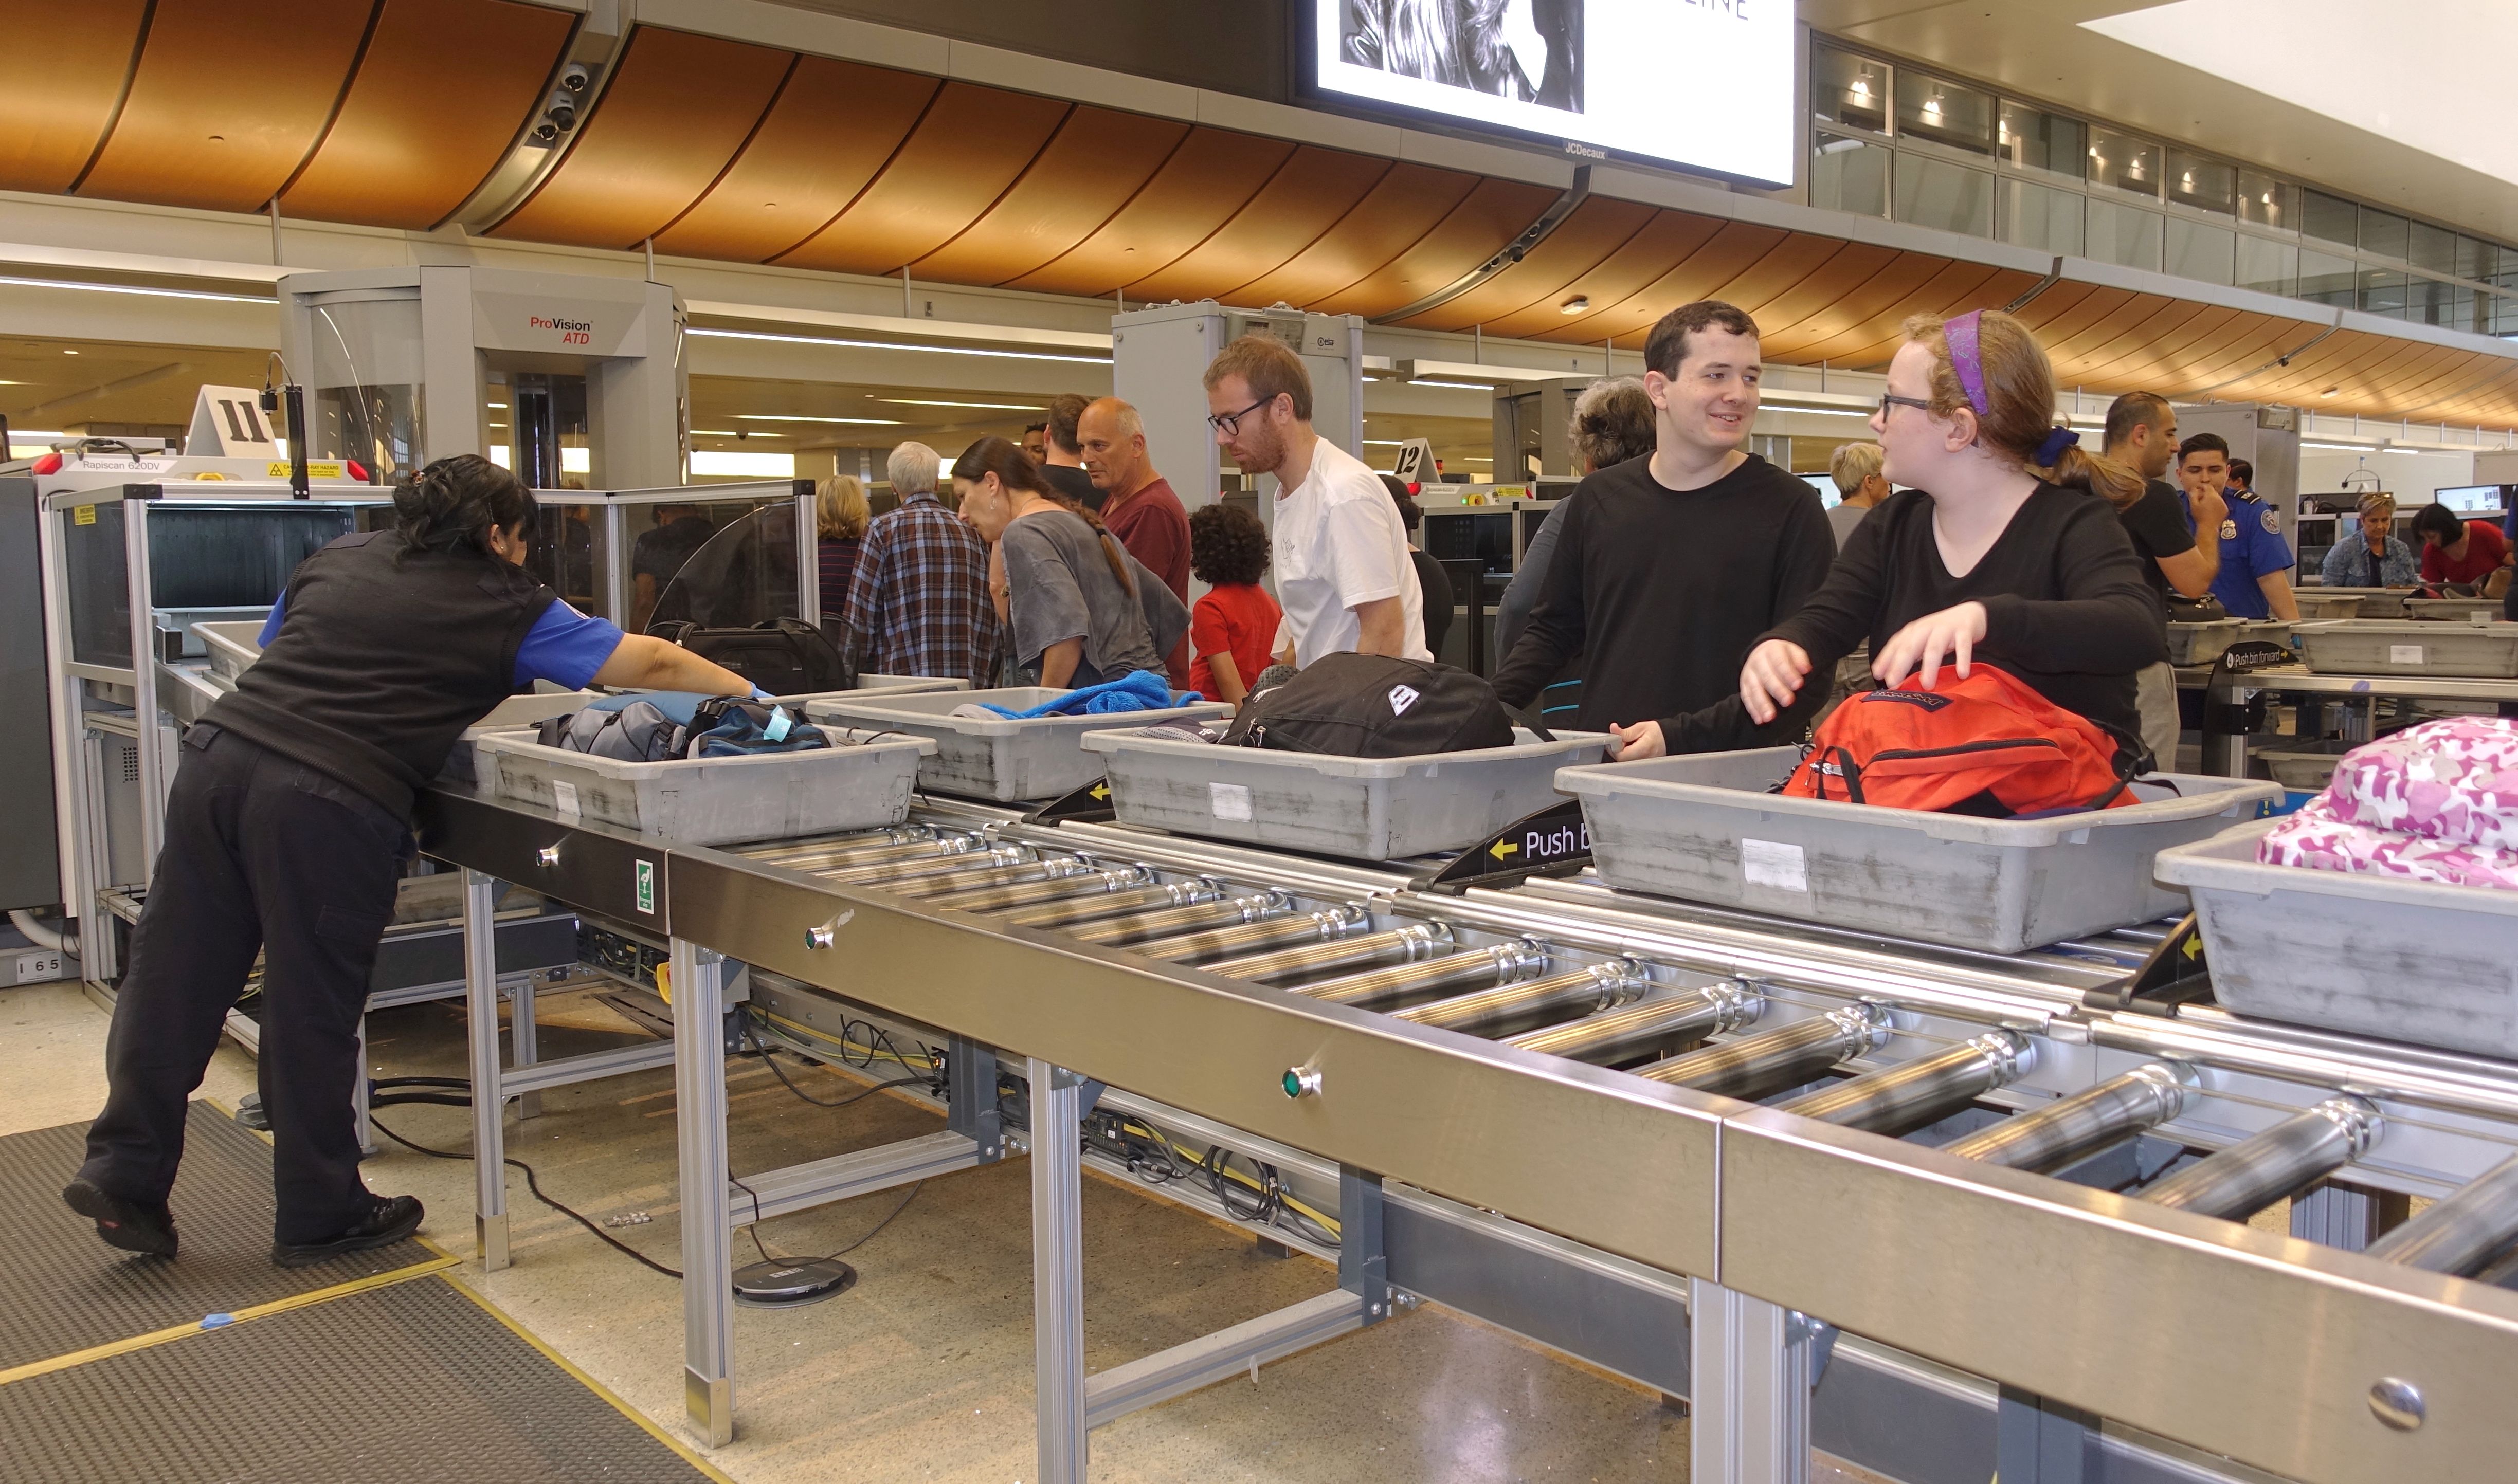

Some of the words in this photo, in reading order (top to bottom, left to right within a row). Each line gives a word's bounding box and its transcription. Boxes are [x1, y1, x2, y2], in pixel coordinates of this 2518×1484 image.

[1565, 142, 1605, 160] JCDecaux
[531, 317, 590, 331] ProVision
[563, 332, 590, 344] ATD
[217, 399, 269, 442] 11
[83, 461, 125, 470] Rapiscan
[1395, 446, 1419, 474] 12
[2235, 653, 2249, 667] Push
[2250, 651, 2258, 664] bin
[2259, 649, 2280, 663] forward
[1526, 826, 1574, 858] Push
